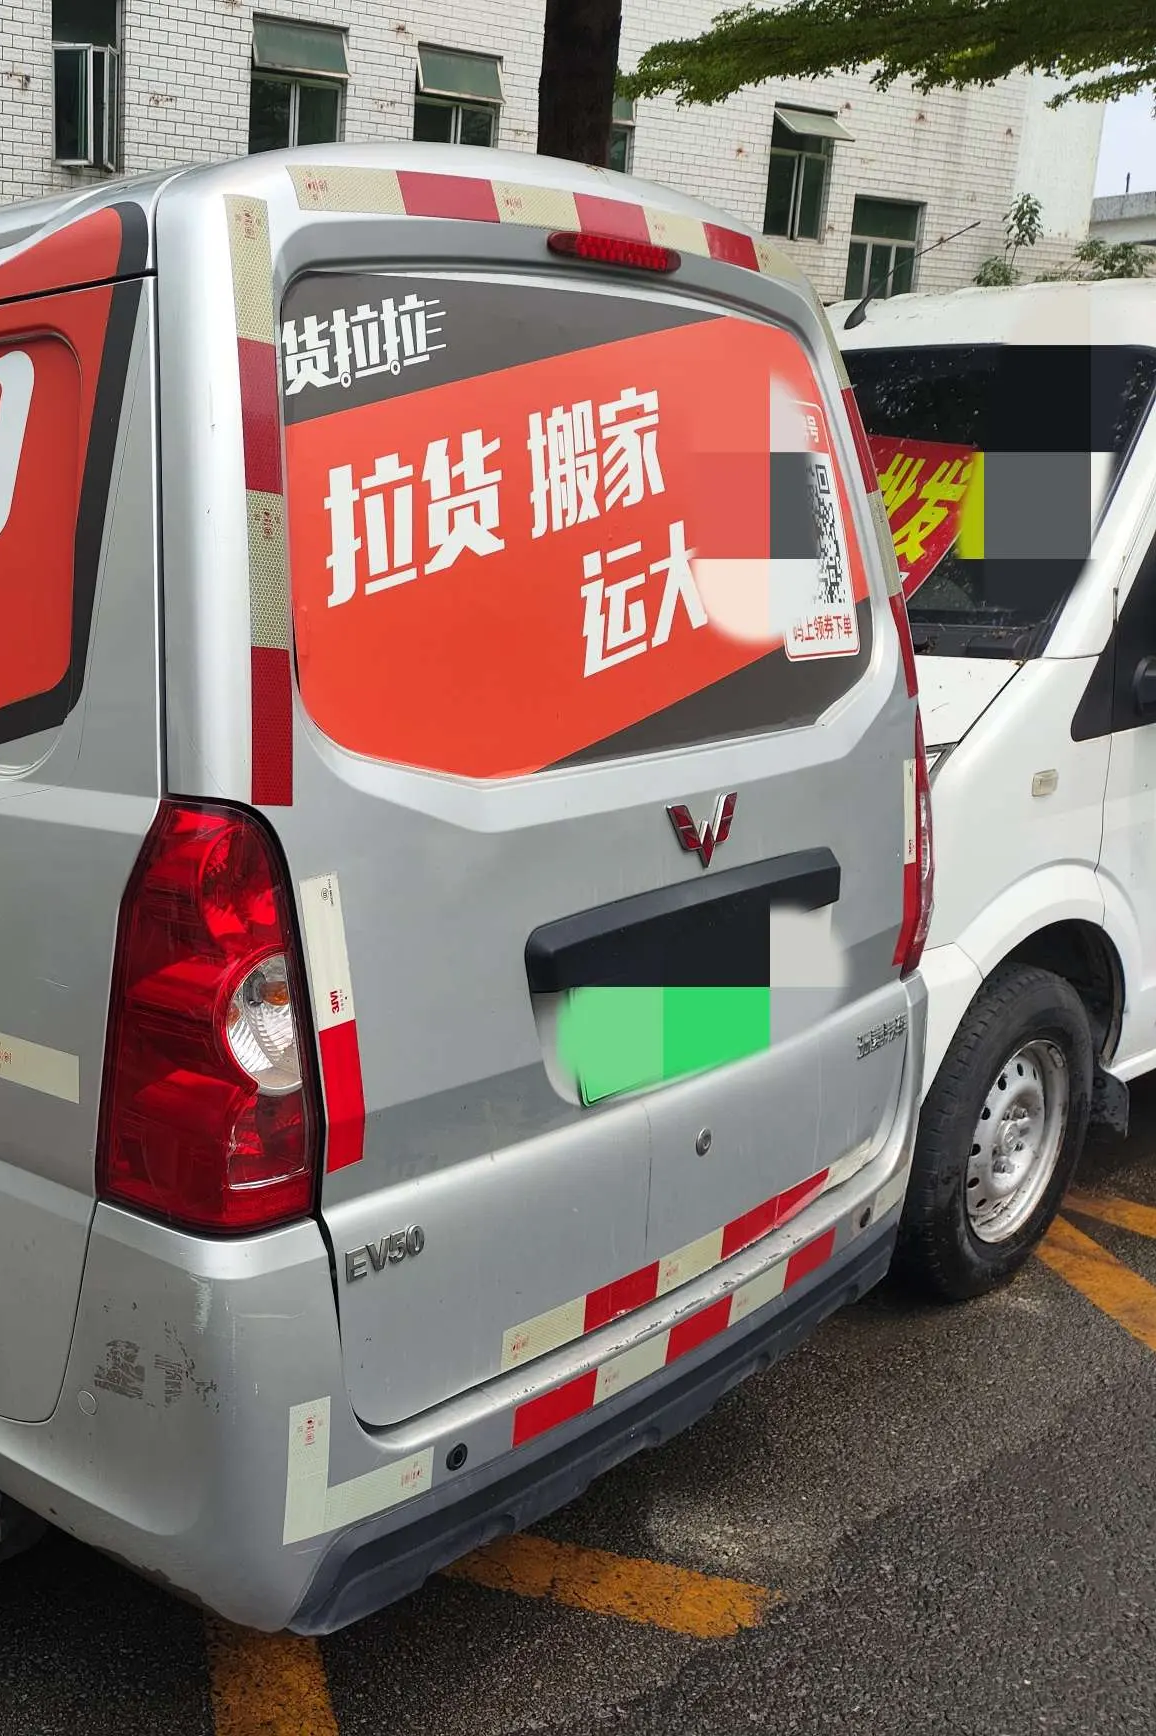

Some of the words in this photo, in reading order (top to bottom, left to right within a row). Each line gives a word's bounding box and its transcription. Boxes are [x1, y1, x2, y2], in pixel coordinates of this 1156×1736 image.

[282, 293, 446, 395] 货拉拉
[324, 429, 505, 608] 拉货
[527, 386, 666, 541] 搬家
[581, 519, 710, 679] 运大
[345, 1223, 425, 1283] EV50
